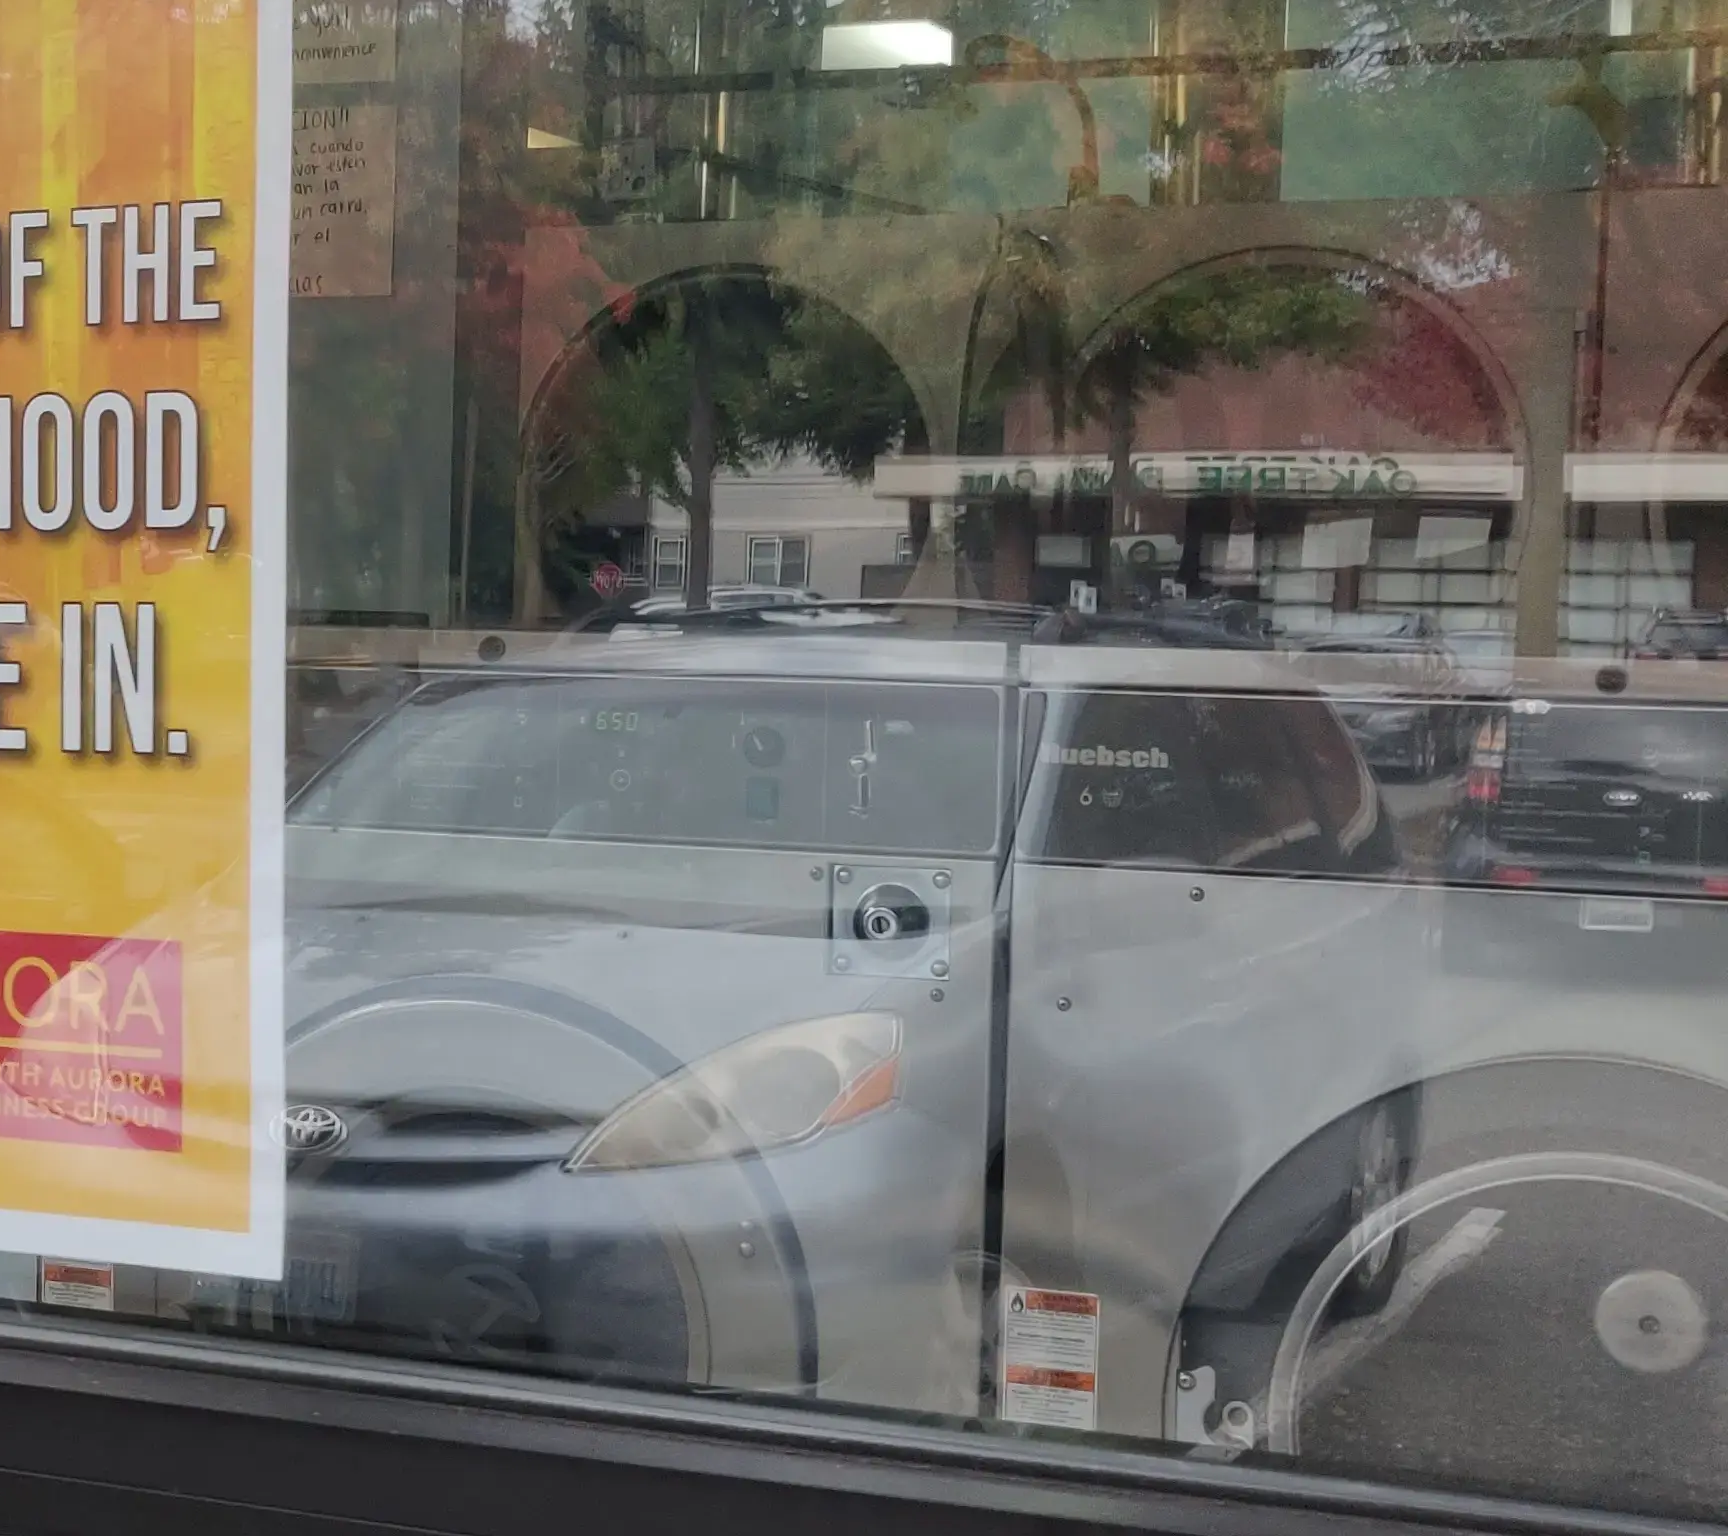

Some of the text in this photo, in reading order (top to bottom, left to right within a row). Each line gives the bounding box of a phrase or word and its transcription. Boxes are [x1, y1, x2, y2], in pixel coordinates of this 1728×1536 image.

[71, 199, 223, 325] THE
[60, 602, 190, 758] IN.
[595, 710, 639, 731] 650
[1080, 783, 1094, 806] 6
[49, 1067, 166, 1098] AURORA
